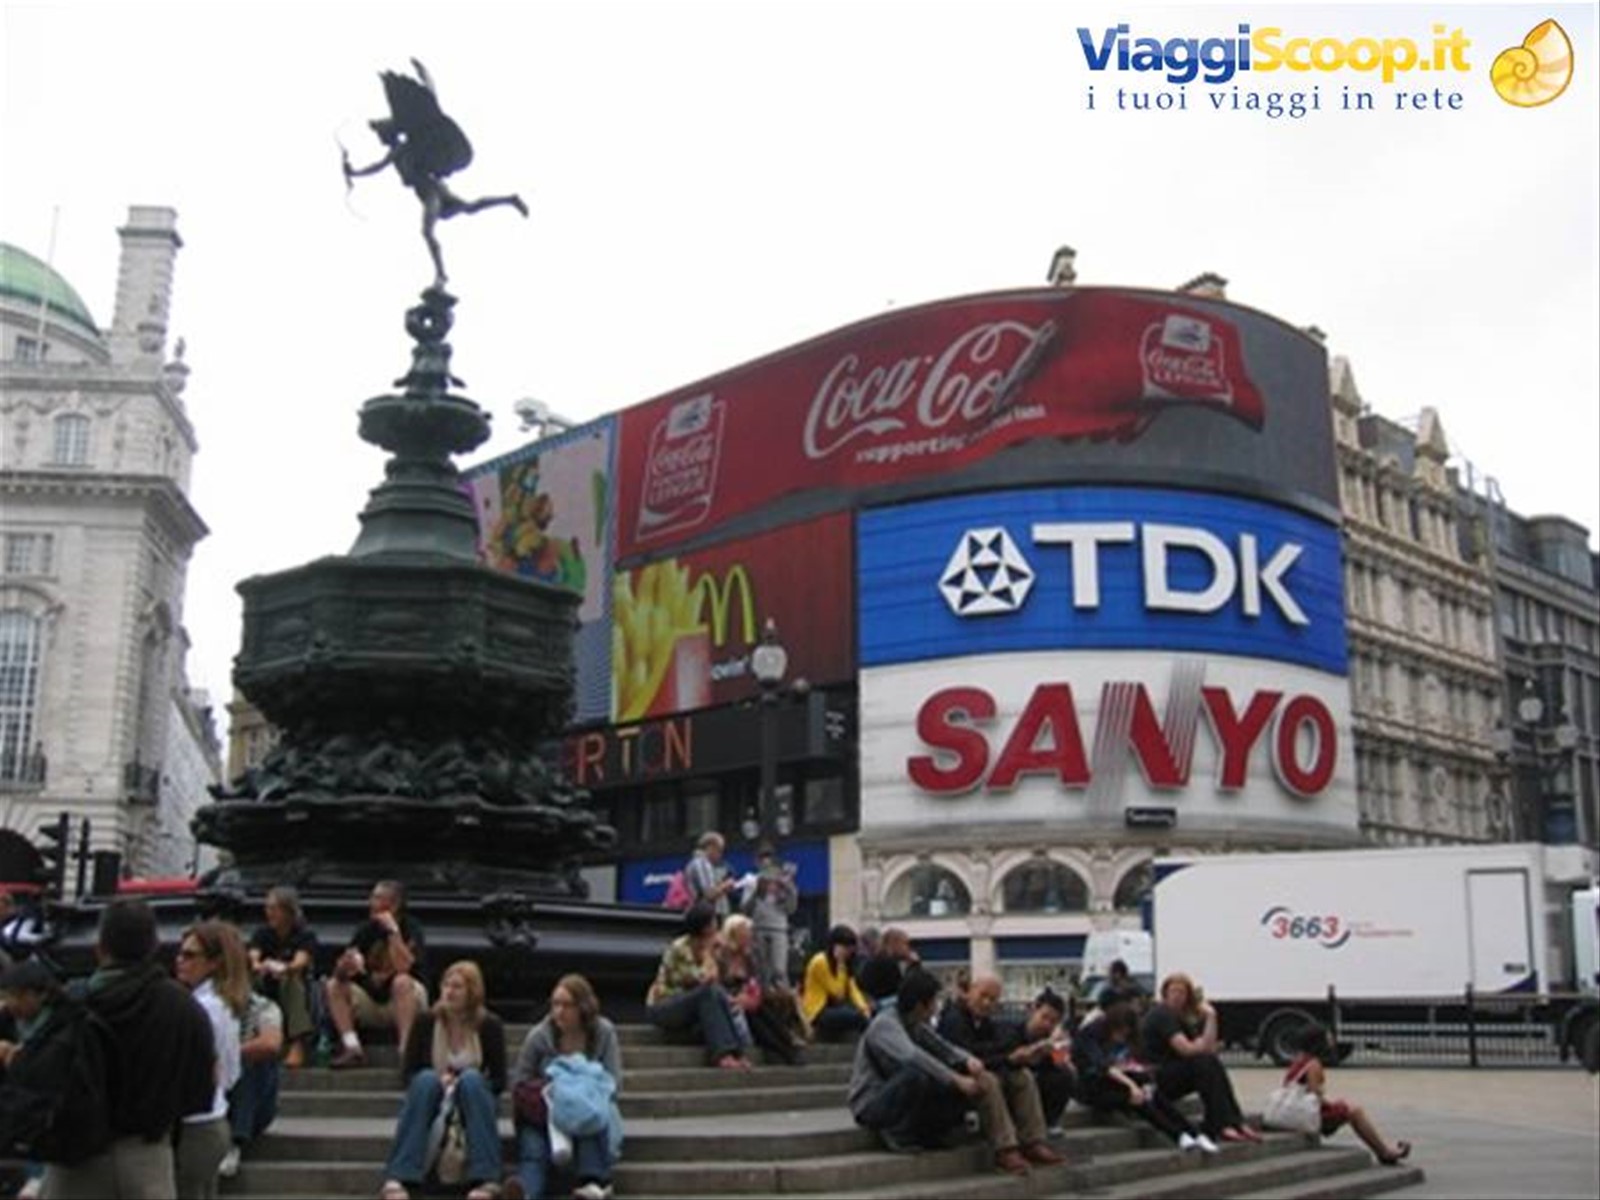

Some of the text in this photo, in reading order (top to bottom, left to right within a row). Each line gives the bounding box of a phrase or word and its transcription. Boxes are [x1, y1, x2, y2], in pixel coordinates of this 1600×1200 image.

[1032, 521, 1310, 625] TDK
[905, 680, 1340, 799] SANYO
[1271, 915, 1340, 939] 3663
